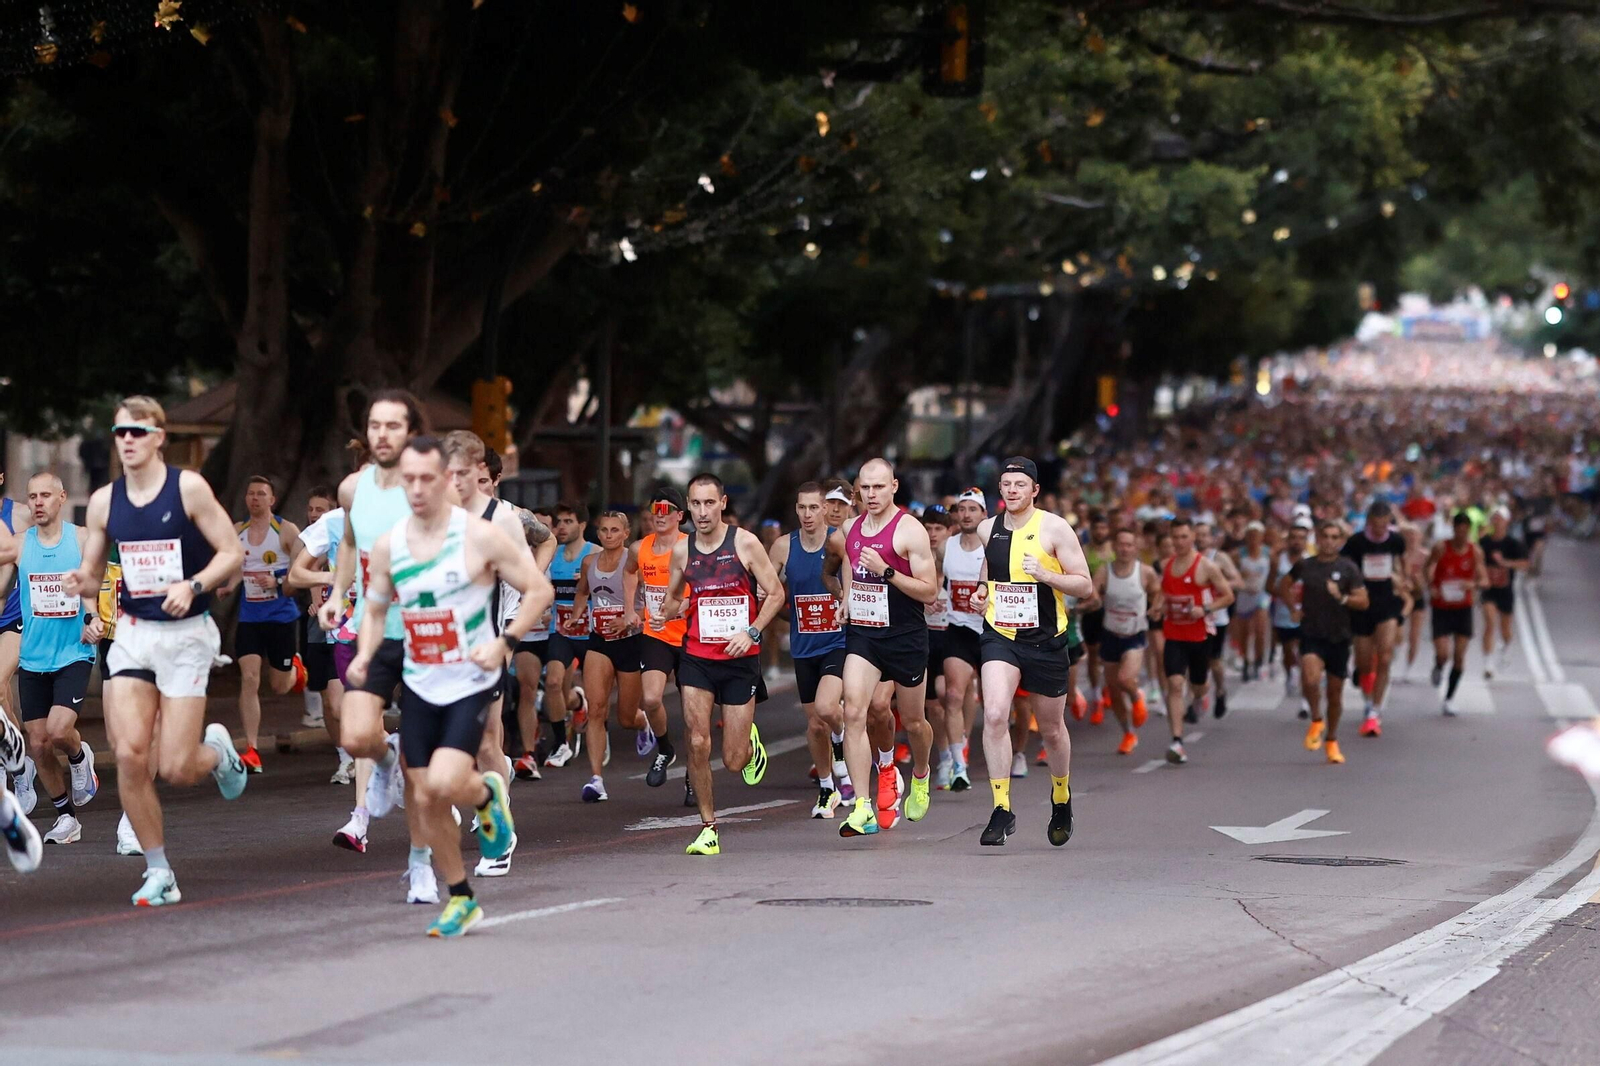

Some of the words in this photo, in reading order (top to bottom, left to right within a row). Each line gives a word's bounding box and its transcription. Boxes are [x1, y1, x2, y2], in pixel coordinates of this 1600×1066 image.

[132, 554, 166, 567] 14616
[857, 583, 880, 592] GENERALI
[1002, 585, 1029, 593] GENERALI
[710, 598, 741, 606] GENERALI
[852, 593, 876, 603] 29583
[999, 594, 1025, 604] 14504
[807, 604, 823, 612] 484
[708, 608, 738, 618] 14553
